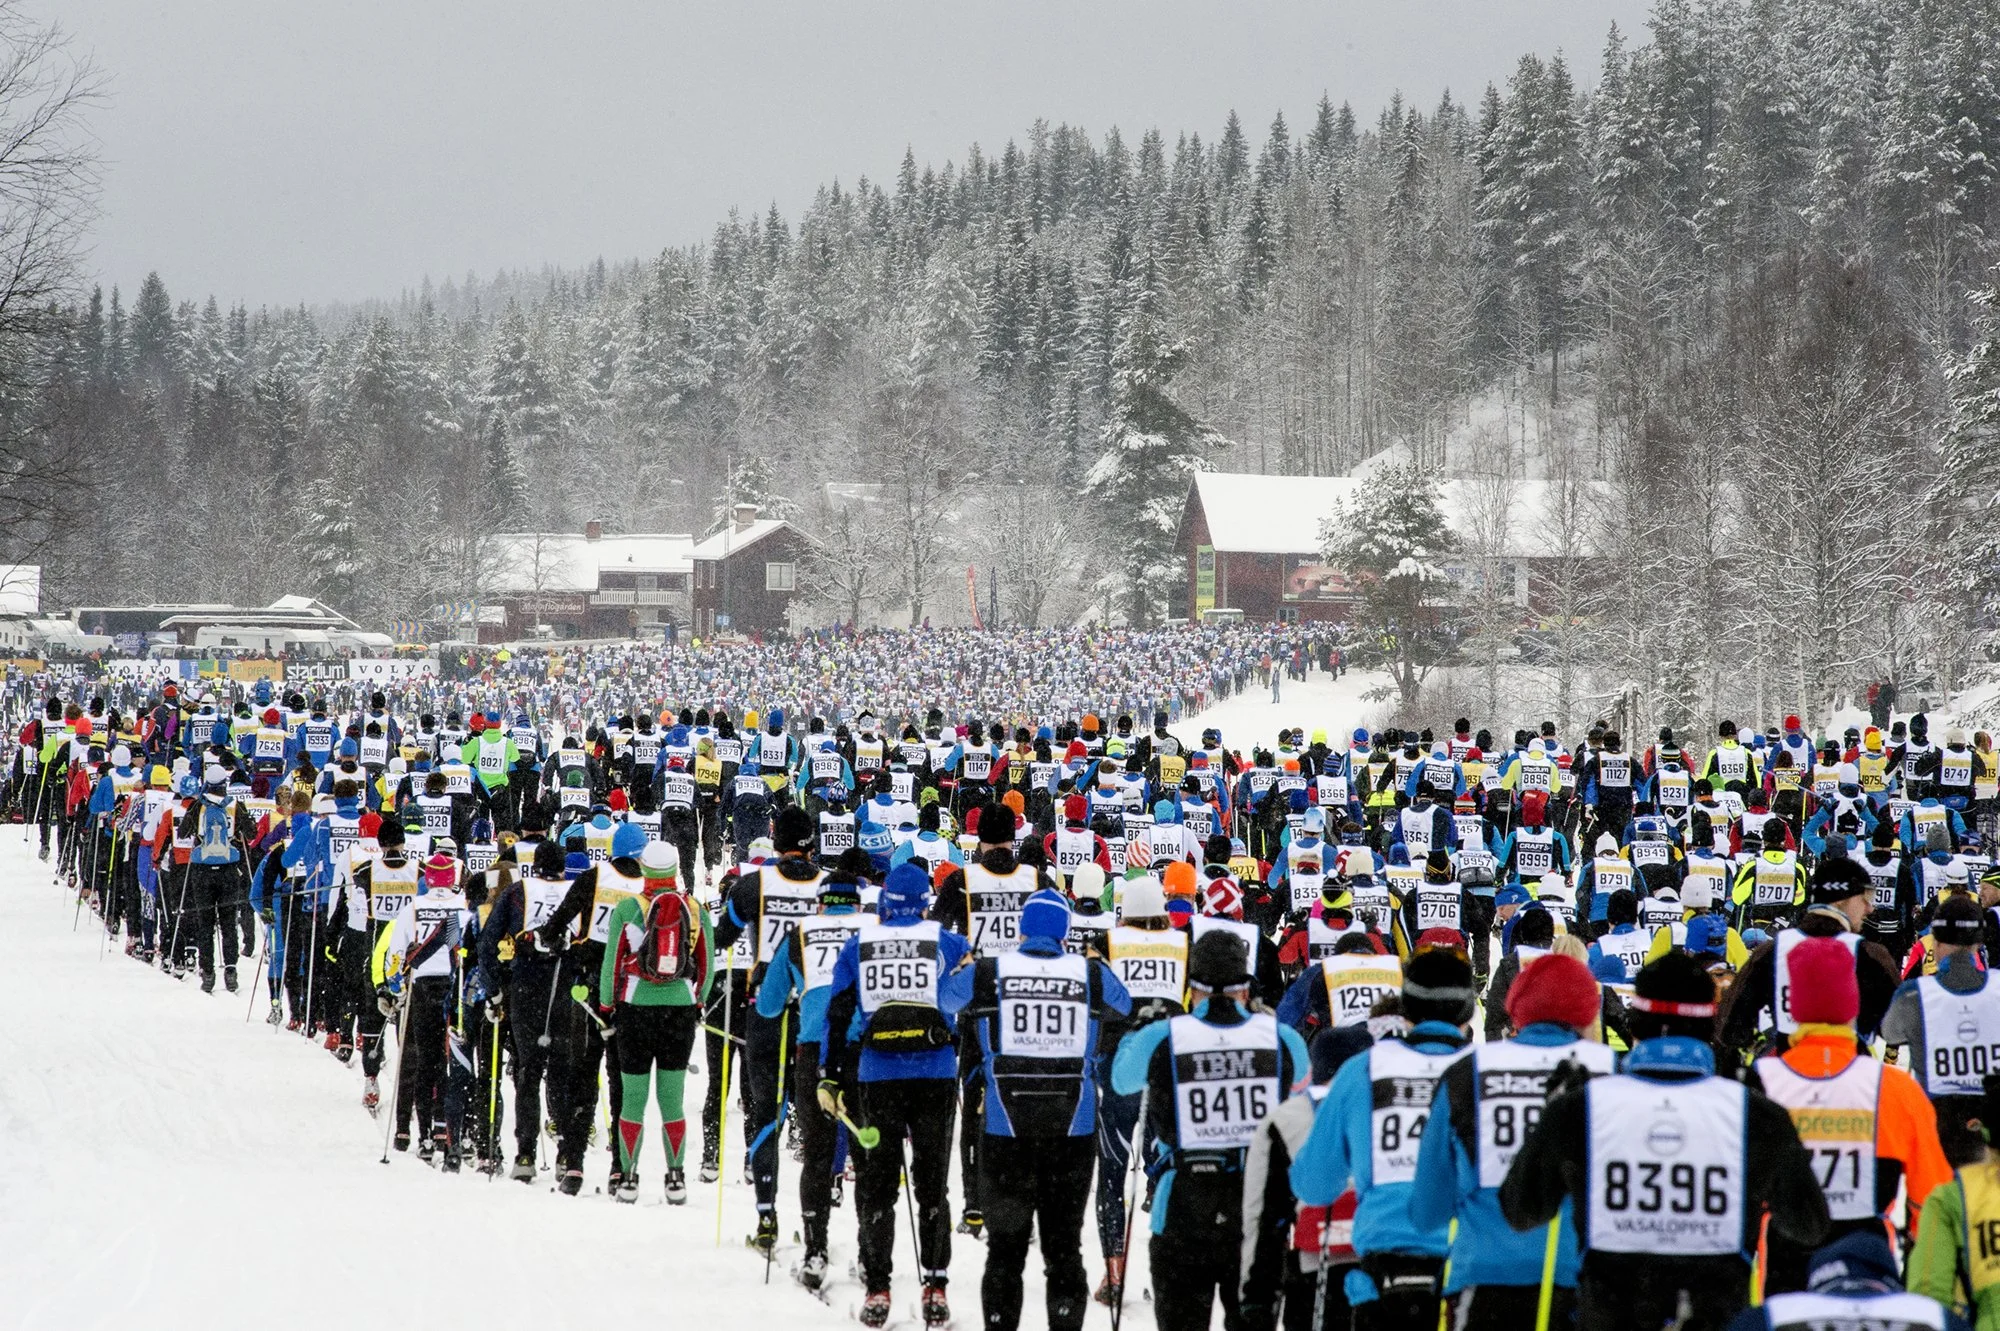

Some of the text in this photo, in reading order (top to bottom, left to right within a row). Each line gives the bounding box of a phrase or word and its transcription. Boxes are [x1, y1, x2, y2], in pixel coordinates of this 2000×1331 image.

[247, 667, 277, 680] preem
[286, 663, 344, 680] stadium
[359, 664, 431, 676] VOLVO
[257, 741, 281, 751] 7626
[307, 736, 330, 746] 15933
[363, 748, 384, 757] 10081
[762, 749, 784, 760] 8331
[480, 757, 502, 768] 8021
[857, 756, 881, 768] 8678
[968, 762, 988, 773] 11147
[1605, 769, 1627, 780] 11127
[1721, 765, 1744, 777] 8368
[1943, 769, 1970, 781] 8747
[1426, 772, 1452, 784] 14668
[1522, 774, 1548, 786] 8896
[1319, 788, 1344, 800] 8366
[1661, 787, 1687, 800] 9231
[1093, 805, 1116, 813] CRAFT
[827, 824, 848, 834] IBM
[823, 834, 854, 848] 10399
[1518, 842, 1544, 852] CRAFT
[1153, 846, 1181, 860] 8004
[1636, 848, 1666, 860] 8949
[1462, 856, 1491, 868] 8957
[1518, 853, 1549, 868] 8999
[1599, 872, 1629, 886] 8791
[1419, 892, 1457, 904] stadium
[1758, 884, 1792, 901] 8707
[980, 893, 1022, 912] IBM
[1420, 904, 1457, 918] 9706
[1647, 912, 1682, 924] CRAFT
[975, 916, 1022, 941] 746
[873, 941, 922, 959] IBM
[1122, 959, 1177, 983] 12911
[866, 964, 929, 991] 8565
[1006, 979, 1068, 992] CRAFT
[870, 991, 926, 1002] VASALOPPET
[1013, 1003, 1077, 1037] 8191
[1014, 1037, 1075, 1047] VASALOPPET
[1192, 1050, 1258, 1080] IBM
[1392, 1079, 1433, 1106] IB
[1189, 1085, 1266, 1123] 8416
[1795, 1112, 1874, 1139] preem
[1604, 1161, 1729, 1217] 8396
[1612, 1217, 1722, 1236] VASALOPPET
